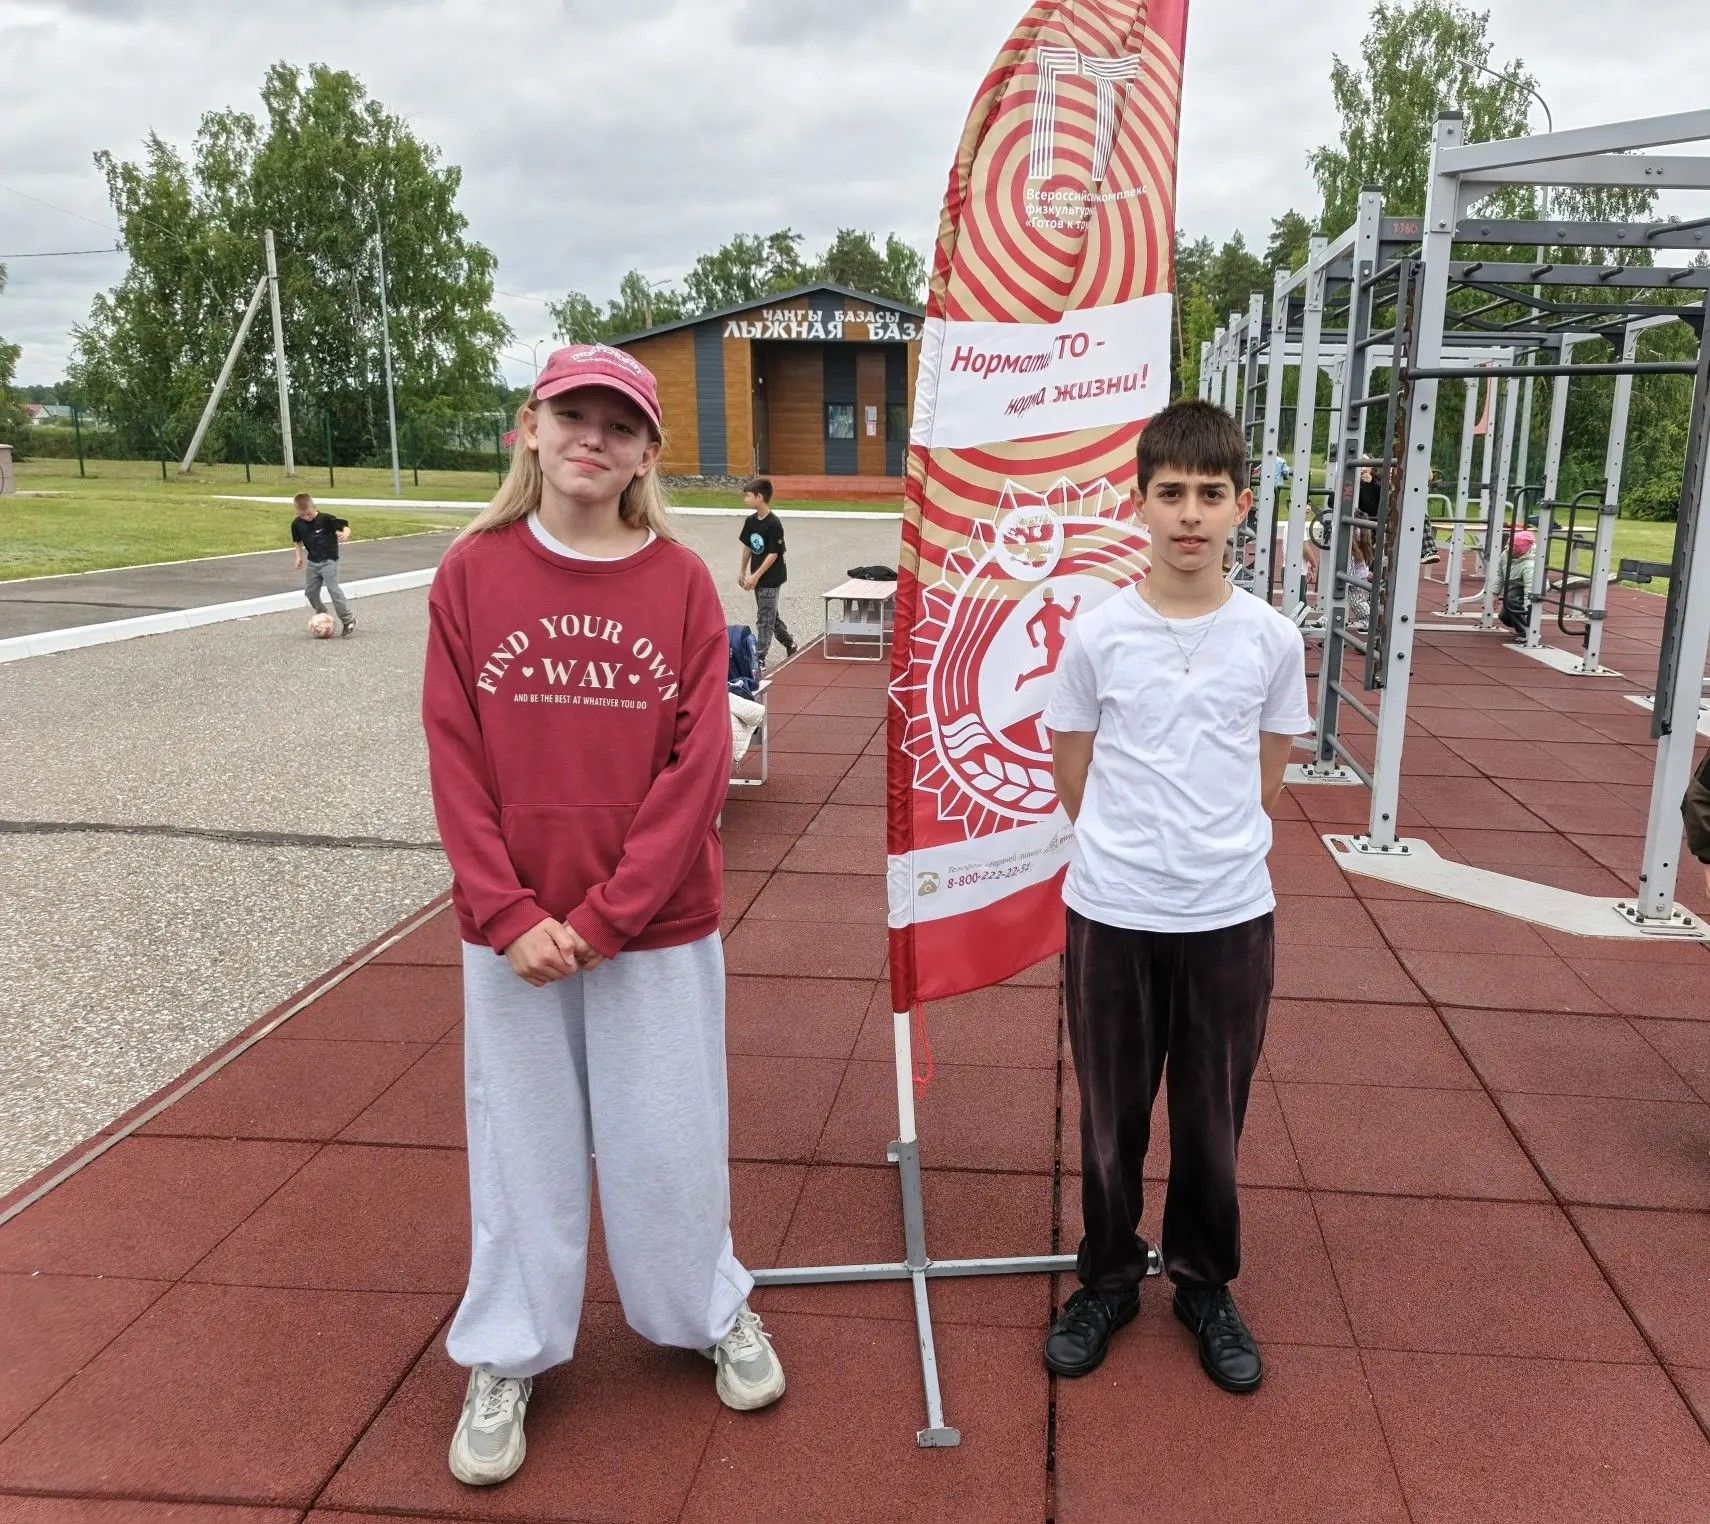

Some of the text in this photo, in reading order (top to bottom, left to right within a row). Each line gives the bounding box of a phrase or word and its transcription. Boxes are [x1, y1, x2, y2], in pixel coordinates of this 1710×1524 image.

[1025, 216, 1064, 229] «Готов
[835, 311, 899, 324] БАЗАСЫ
[723, 320, 843, 340] ЛЫЖНАЯ
[1053, 363, 1149, 403] жизни!
[477, 614, 679, 701] FIND YOUR OWN
[541, 658, 623, 689] WAY
[514, 693, 647, 710] AND BE THE BEST AT WHATEVER YOU DO
